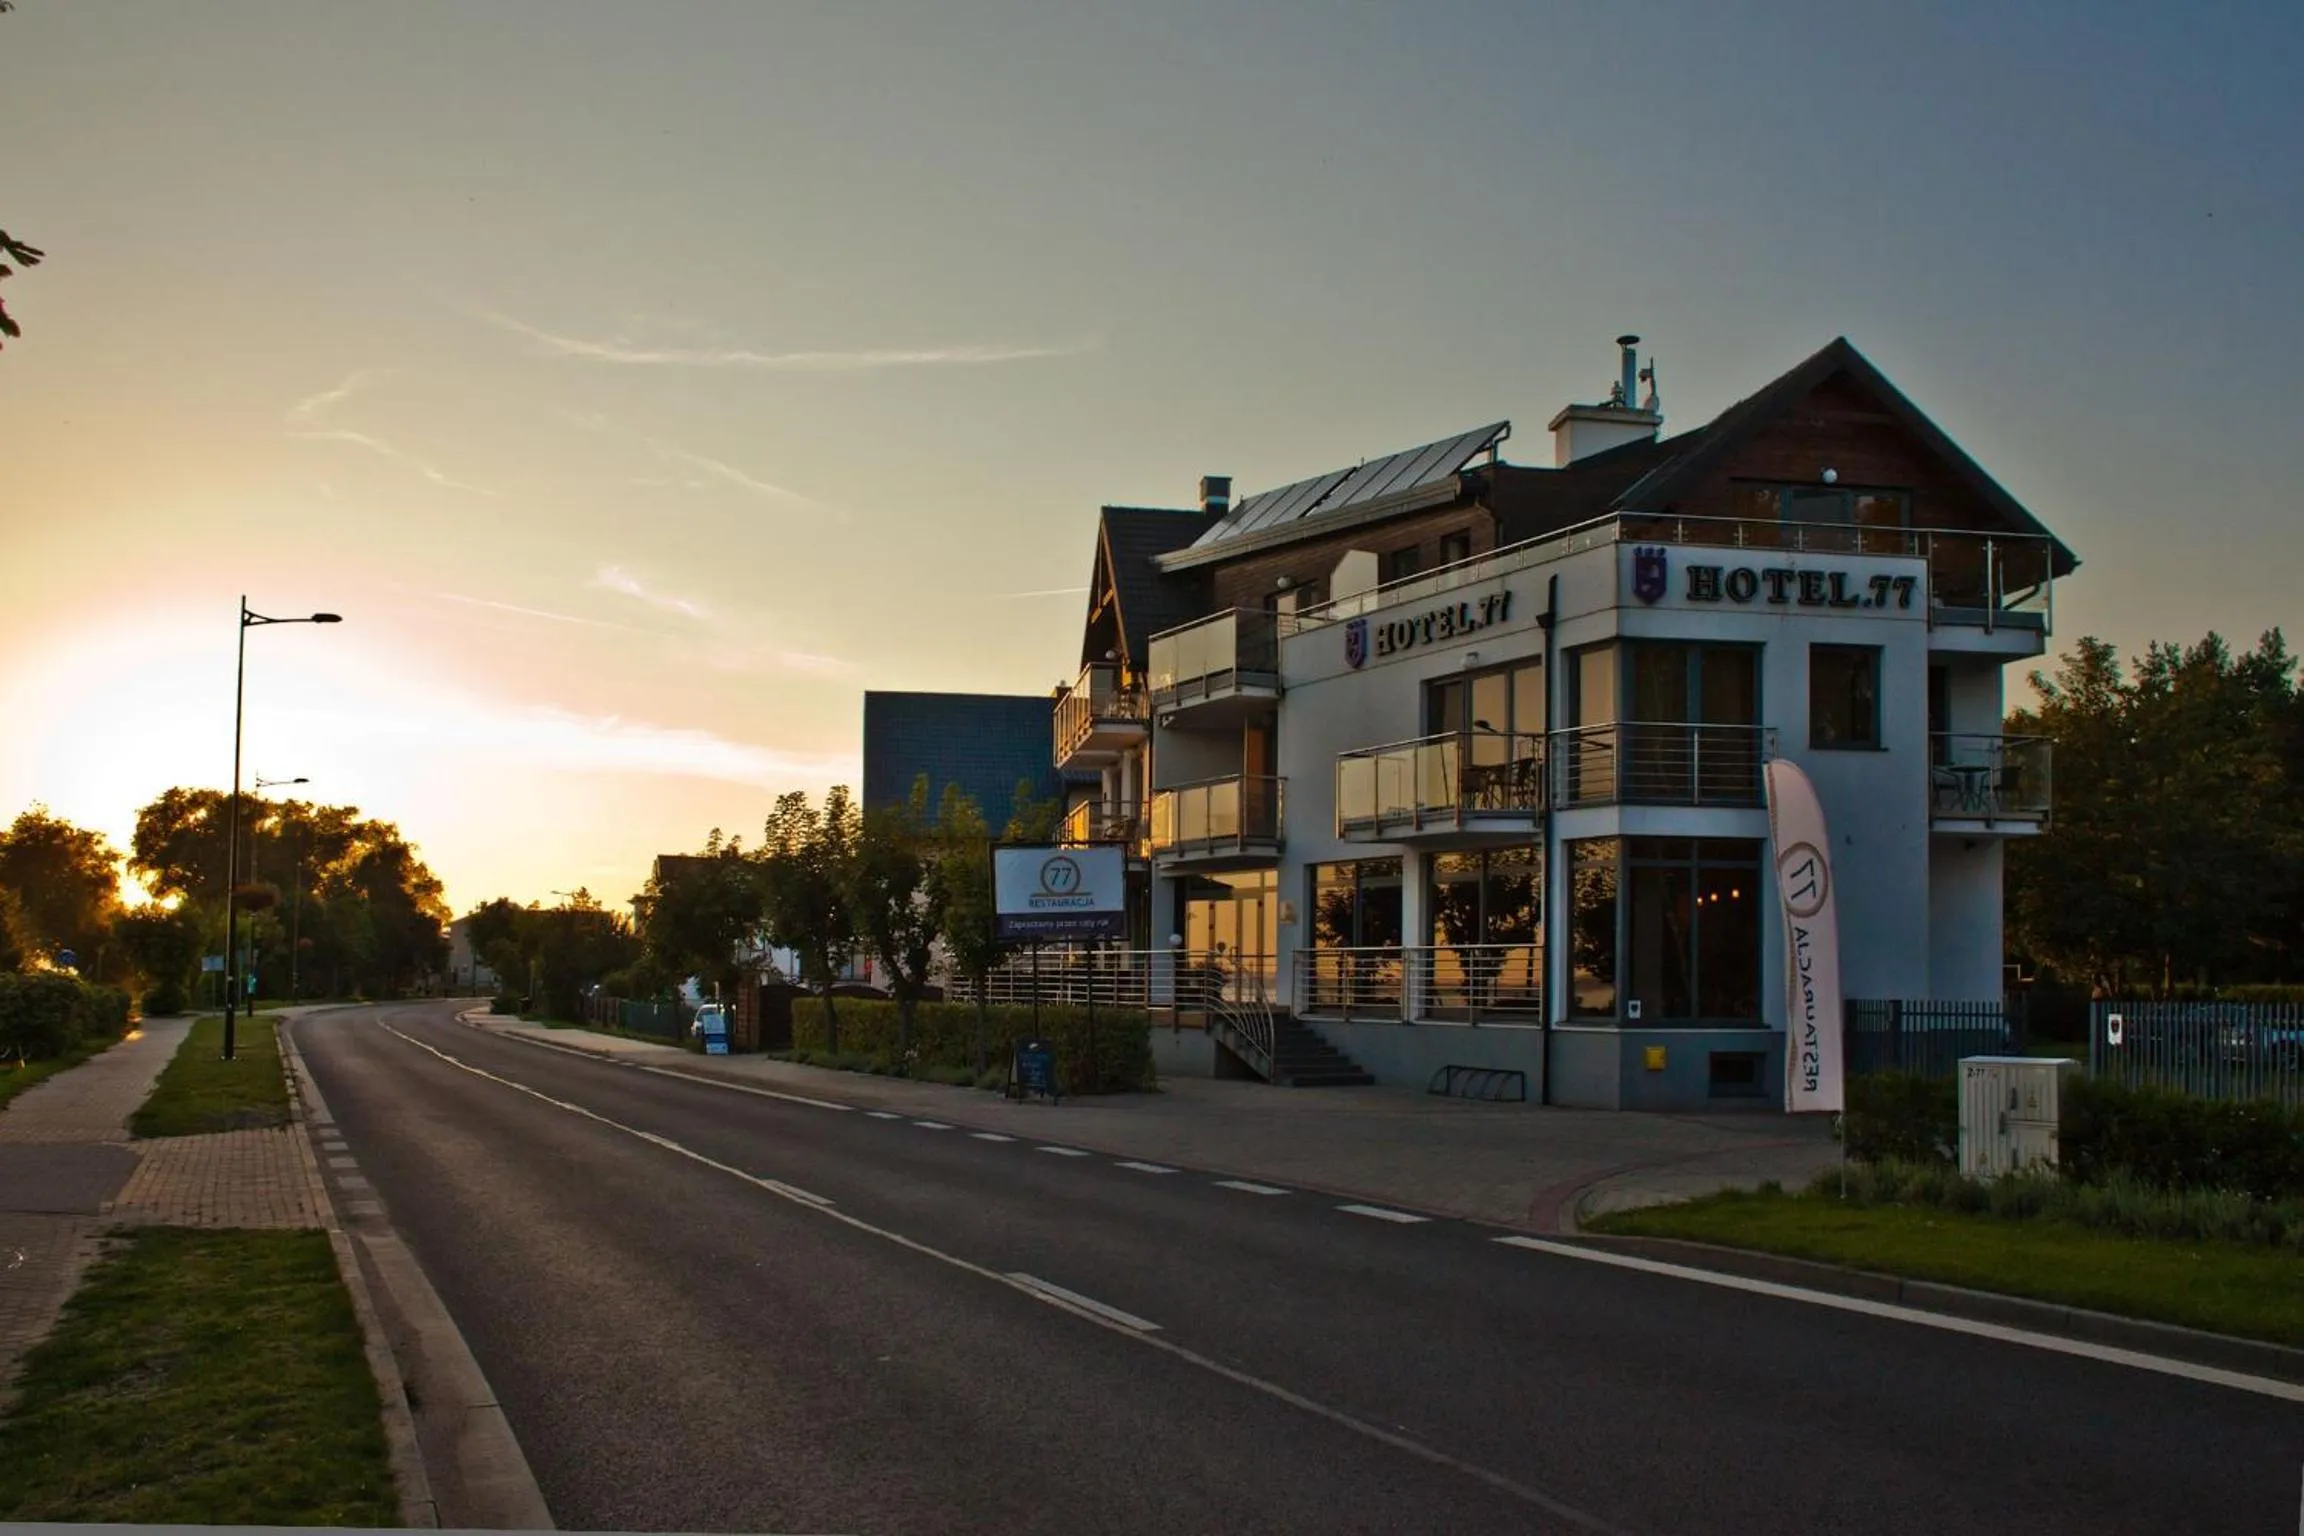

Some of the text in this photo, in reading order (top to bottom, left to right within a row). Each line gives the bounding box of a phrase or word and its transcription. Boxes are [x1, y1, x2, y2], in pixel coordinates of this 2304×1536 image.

[1685, 565, 1917, 609] HOTEL.77
[1376, 590, 1512, 656] HOTEL.77
[1050, 867, 1072, 886] 77
[1028, 898, 1095, 908] RESTAURACJA
